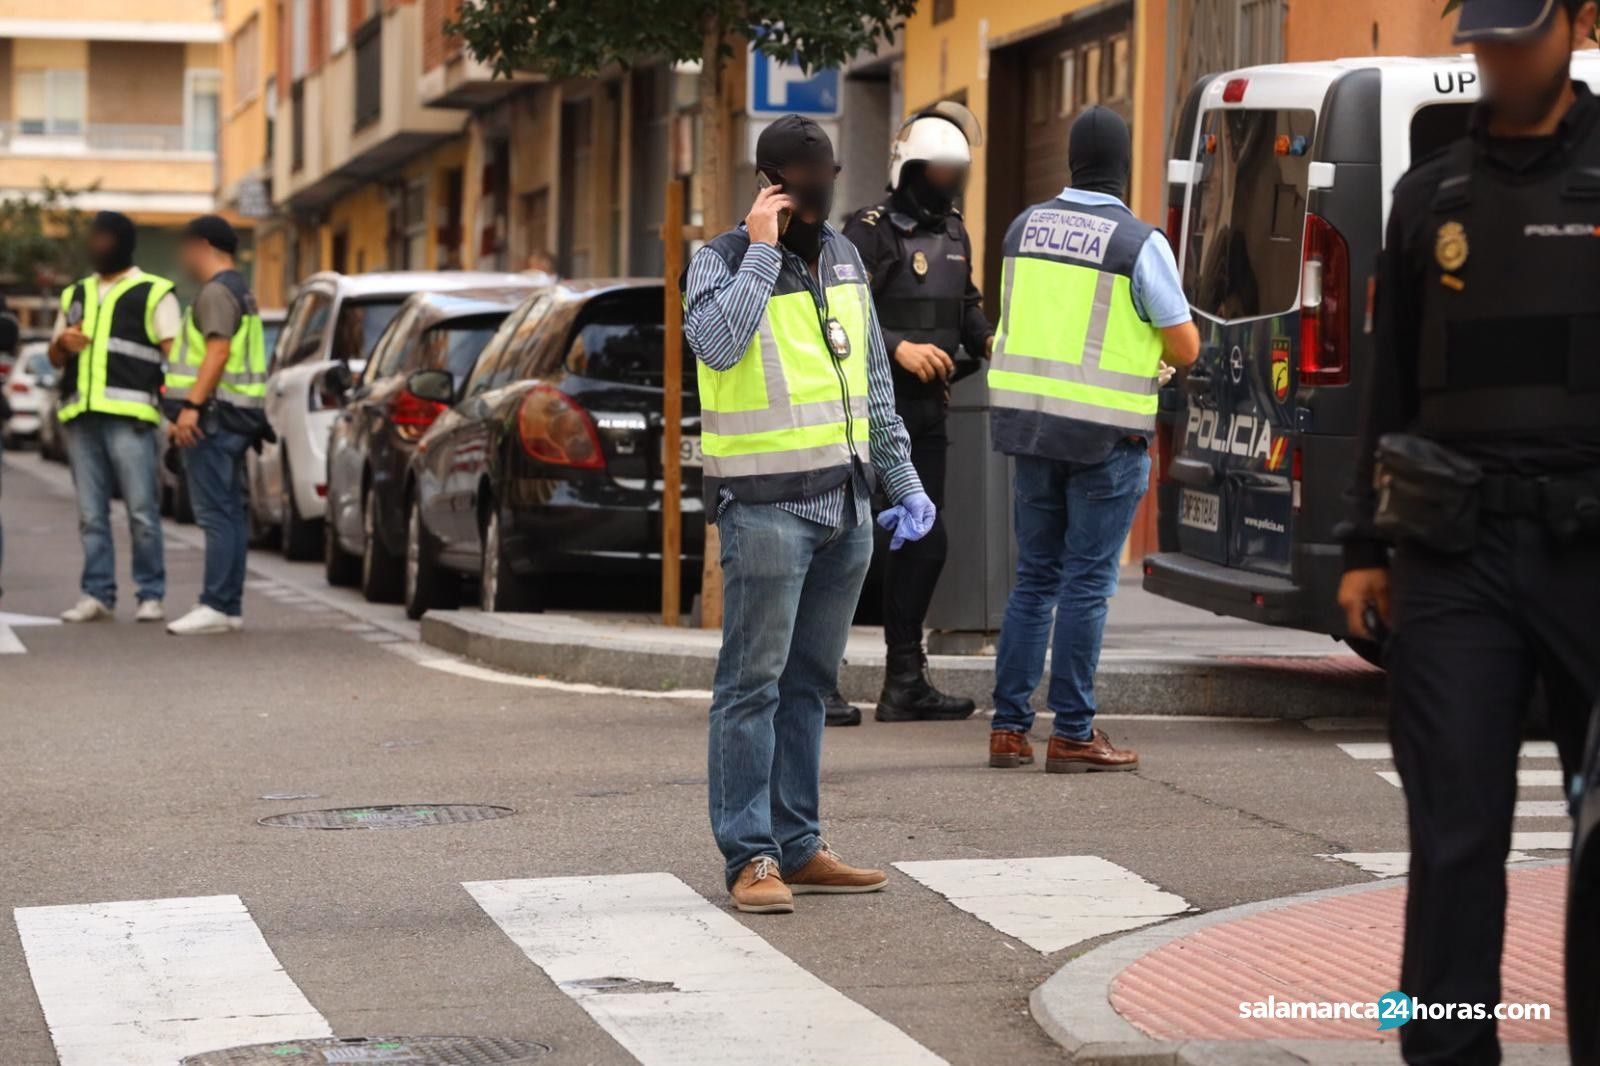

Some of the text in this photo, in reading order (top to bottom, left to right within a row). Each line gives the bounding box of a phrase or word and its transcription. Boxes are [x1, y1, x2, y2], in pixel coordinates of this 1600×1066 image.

[1030, 211, 1112, 234] CUERPO NACIONAL DE
[1023, 226, 1100, 257] POLICIA
